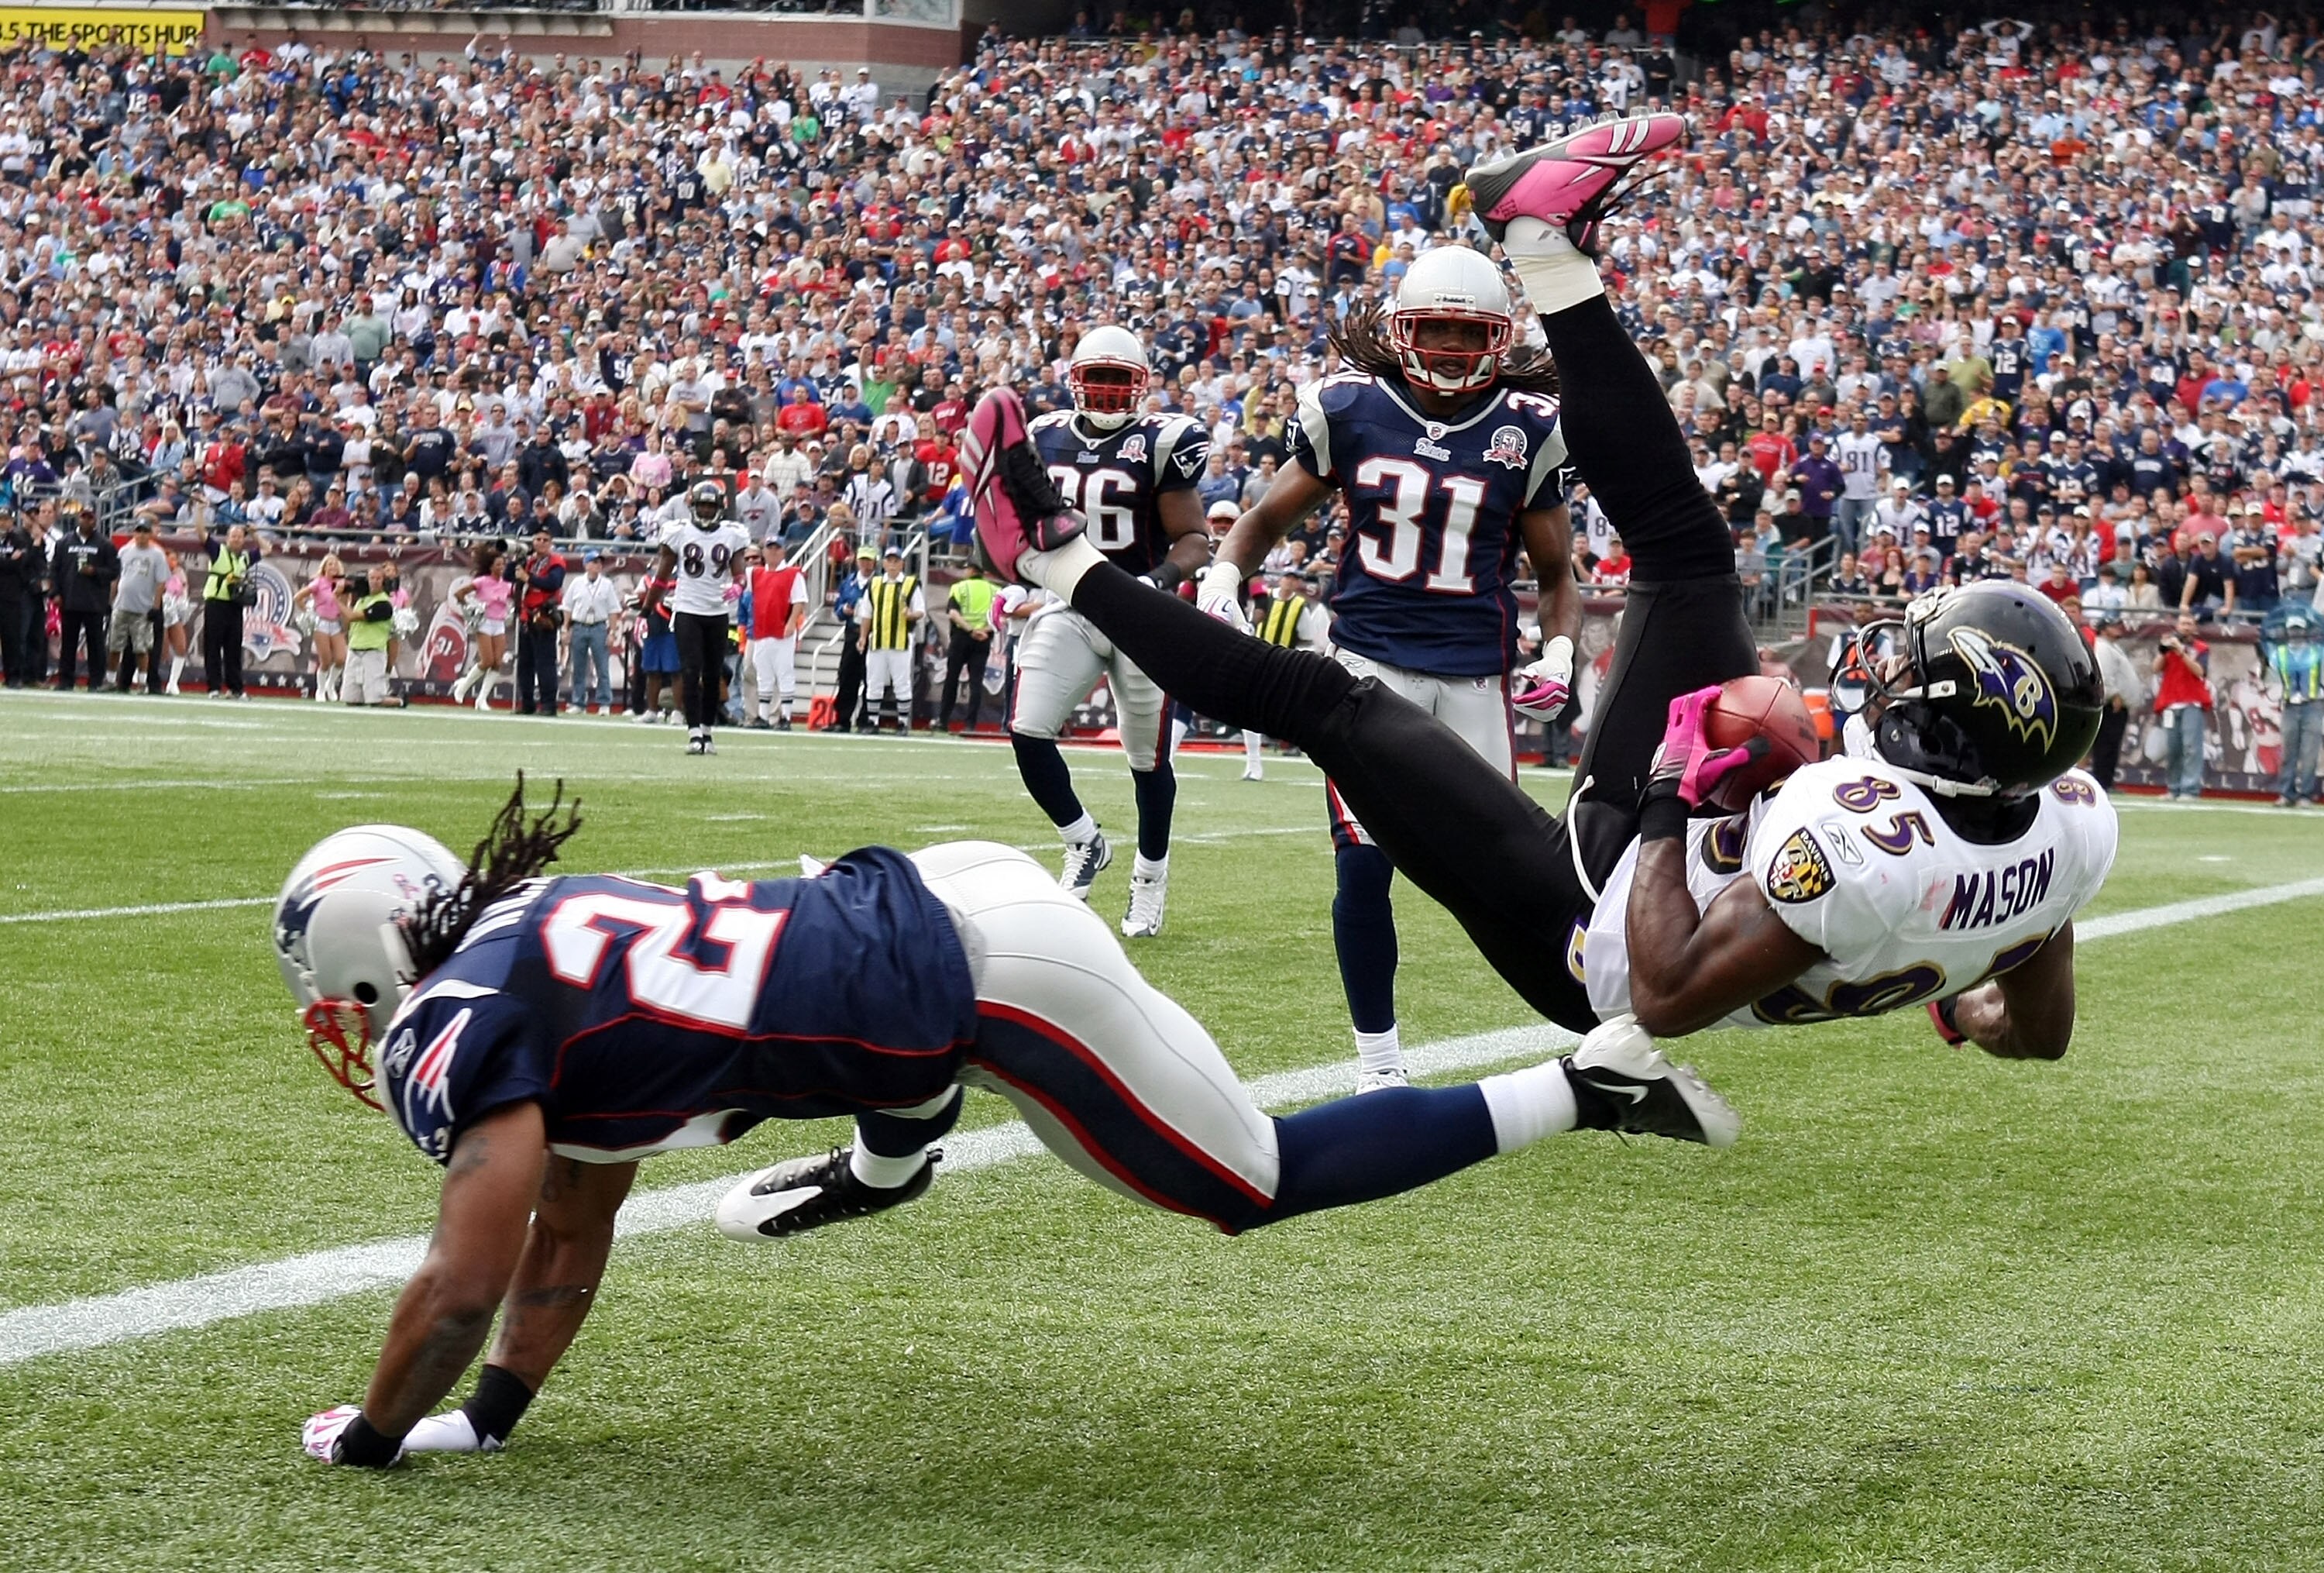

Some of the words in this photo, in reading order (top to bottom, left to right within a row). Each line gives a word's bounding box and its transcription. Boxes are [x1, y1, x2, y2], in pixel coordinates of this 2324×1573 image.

[27, 22, 66, 41] THE
[70, 23, 150, 43] SPORTS
[128, 93, 147, 112] 12
[824, 109, 843, 127] 12
[1544, 123, 1565, 141] 12
[1996, 353, 2017, 373] 12
[820, 387, 843, 409] 54
[1847, 451, 1868, 473] 81
[12, 472, 35, 496] 86
[927, 462, 948, 487] 12
[1356, 454, 1487, 594] 31
[1935, 515, 1960, 537] 12
[683, 542, 731, 579] 89
[1833, 776, 1935, 855] 85
[1800, 830, 1831, 882] RAVENS
[1938, 847, 2054, 930] MASON
